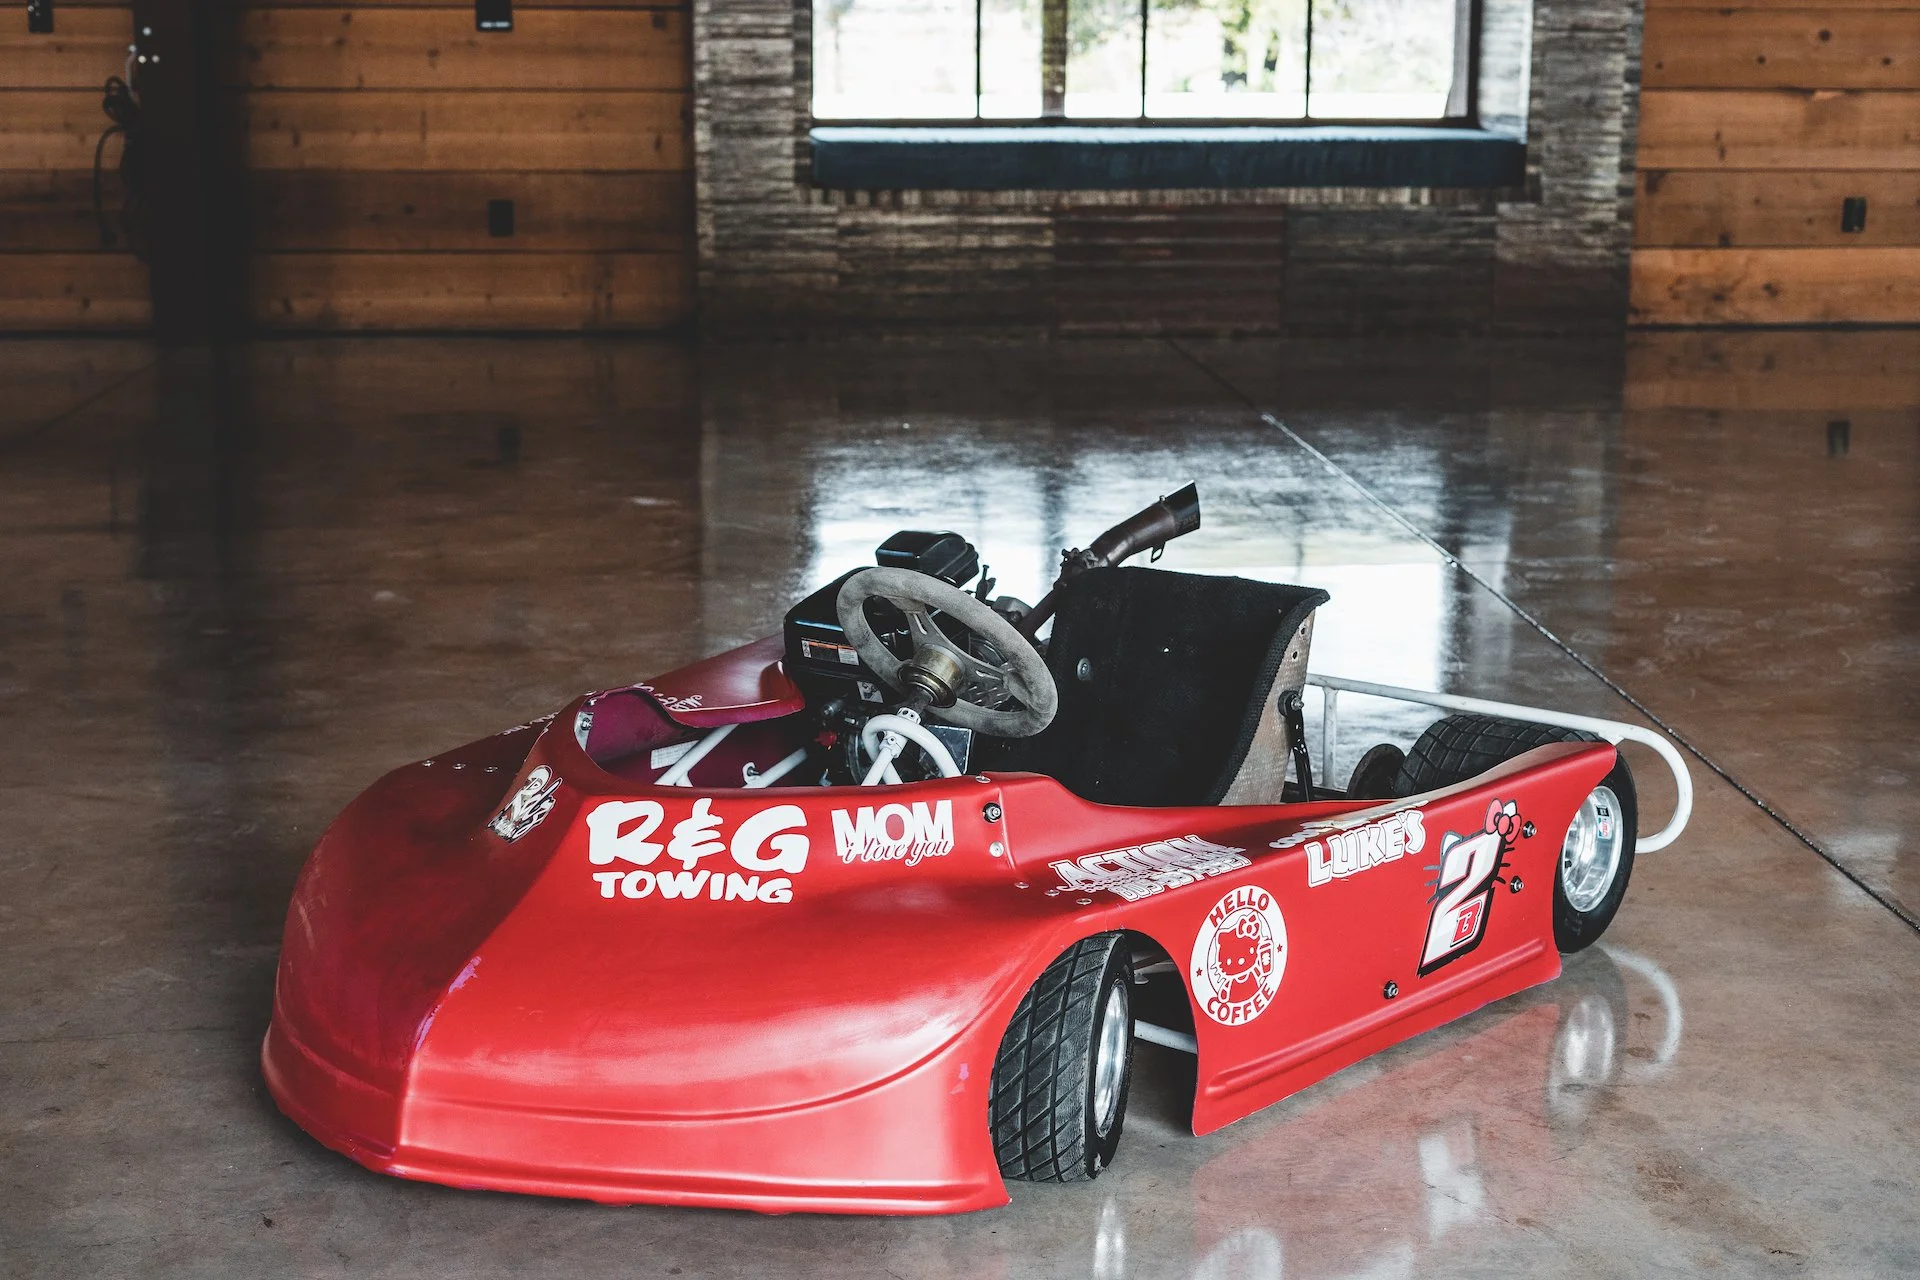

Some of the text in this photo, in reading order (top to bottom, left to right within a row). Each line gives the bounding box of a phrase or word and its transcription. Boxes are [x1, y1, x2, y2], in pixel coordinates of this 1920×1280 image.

[586, 797, 810, 875] R&G
[831, 799, 955, 857] MOM
[863, 836, 907, 863] love
[905, 837, 953, 866] you
[1304, 809, 1427, 888] LUKE'S
[592, 869, 794, 904] TOWING
[1047, 834, 1228, 892] ACTION
[1208, 888, 1270, 928] HELLO
[1419, 829, 1505, 972] 2
[1206, 982, 1275, 1024] COFFEE
